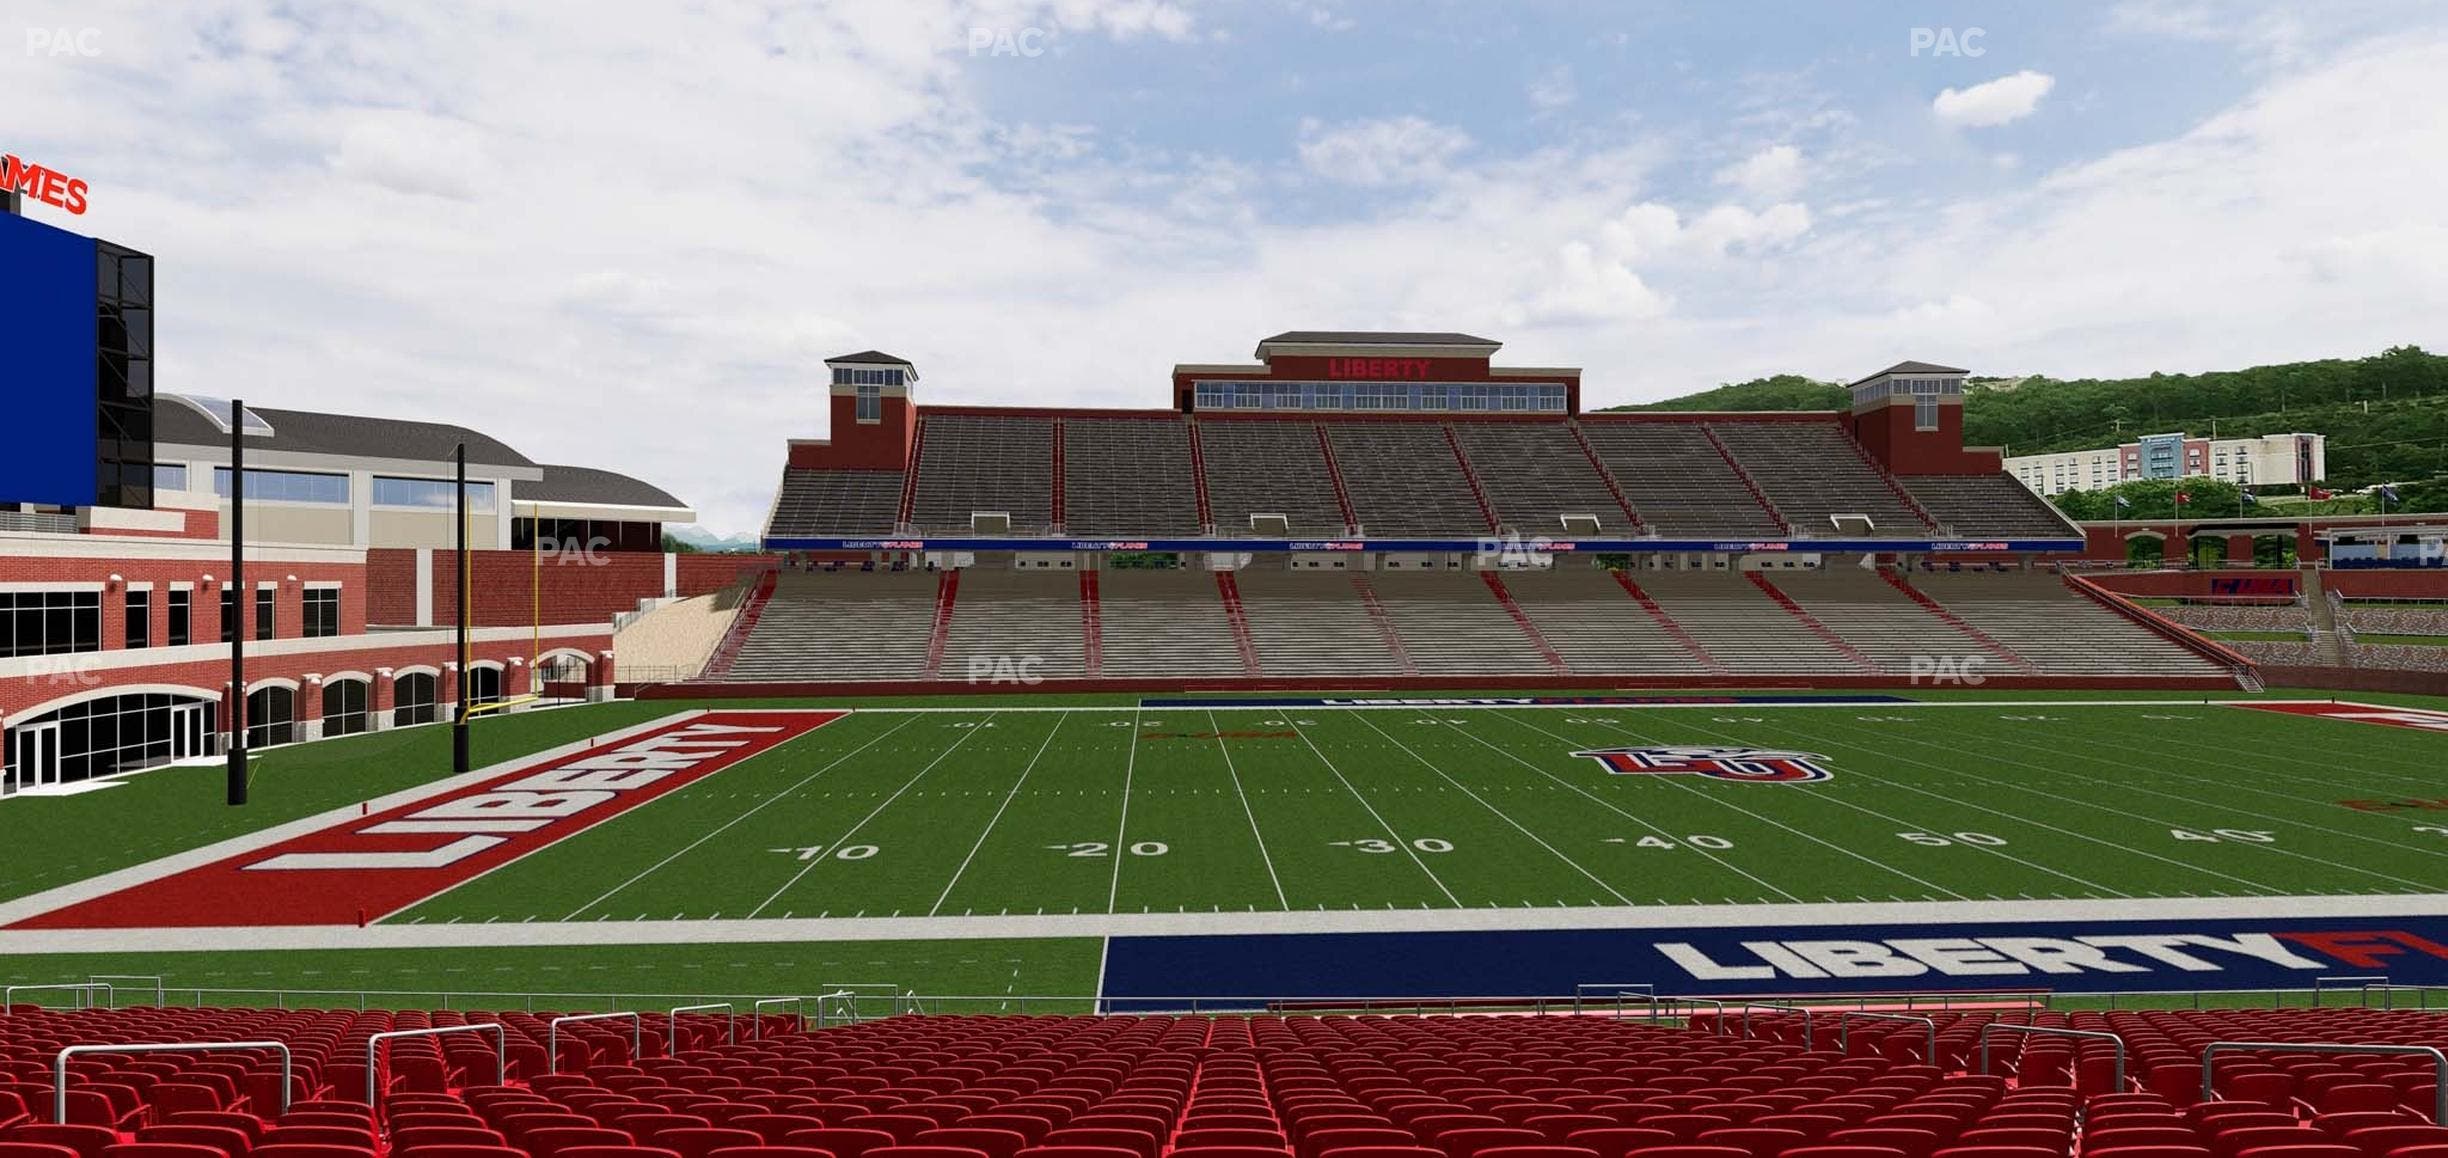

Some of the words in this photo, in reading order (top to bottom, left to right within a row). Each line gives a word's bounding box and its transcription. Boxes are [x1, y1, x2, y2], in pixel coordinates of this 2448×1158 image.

[1328, 358, 1432, 379] LIBERTY
[239, 723, 786, 871] LIBERTY
[1354, 838, 1455, 853] 30
[1636, 834, 1734, 850] 40
[1896, 831, 2009, 846] 50
[1067, 842, 1170, 857] 20
[1653, 932, 2328, 981] LIBERTY
